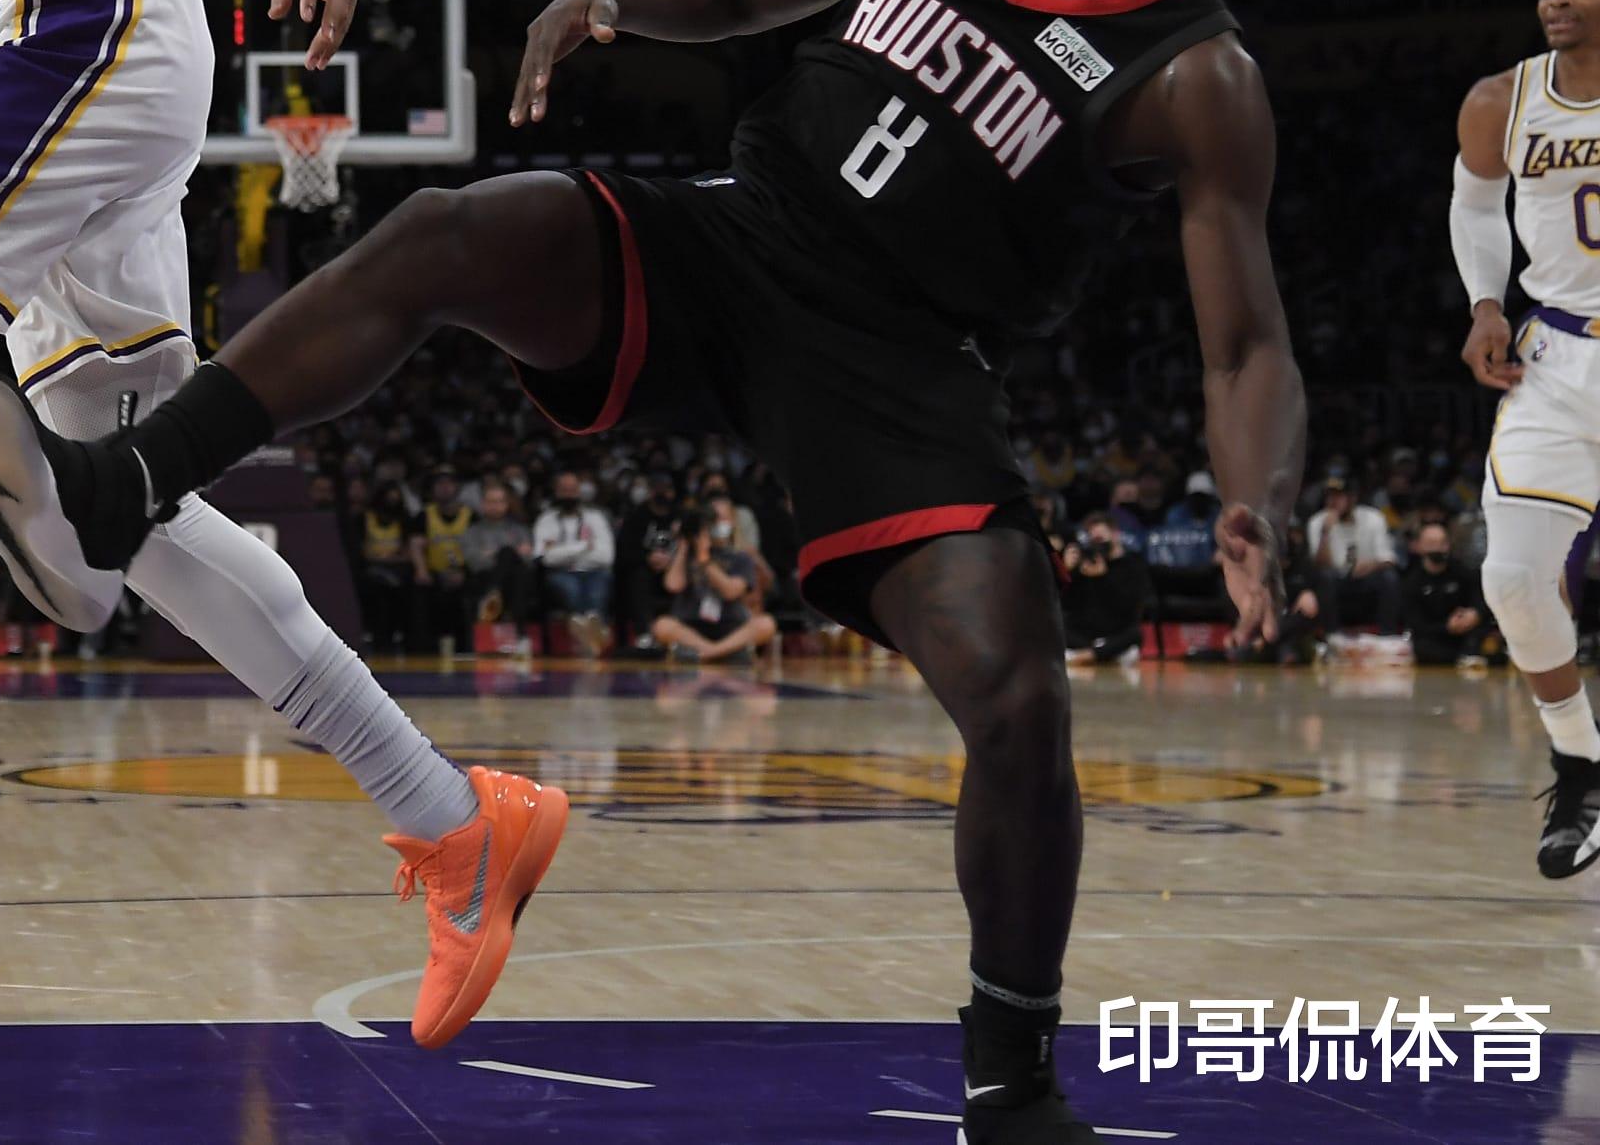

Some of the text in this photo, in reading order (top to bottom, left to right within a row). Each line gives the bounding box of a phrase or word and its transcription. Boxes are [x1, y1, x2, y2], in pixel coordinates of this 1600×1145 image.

[1038, 29, 1100, 85] MONEY
[1051, 23, 1108, 77] credit karma
[839, 94, 930, 199] 8
